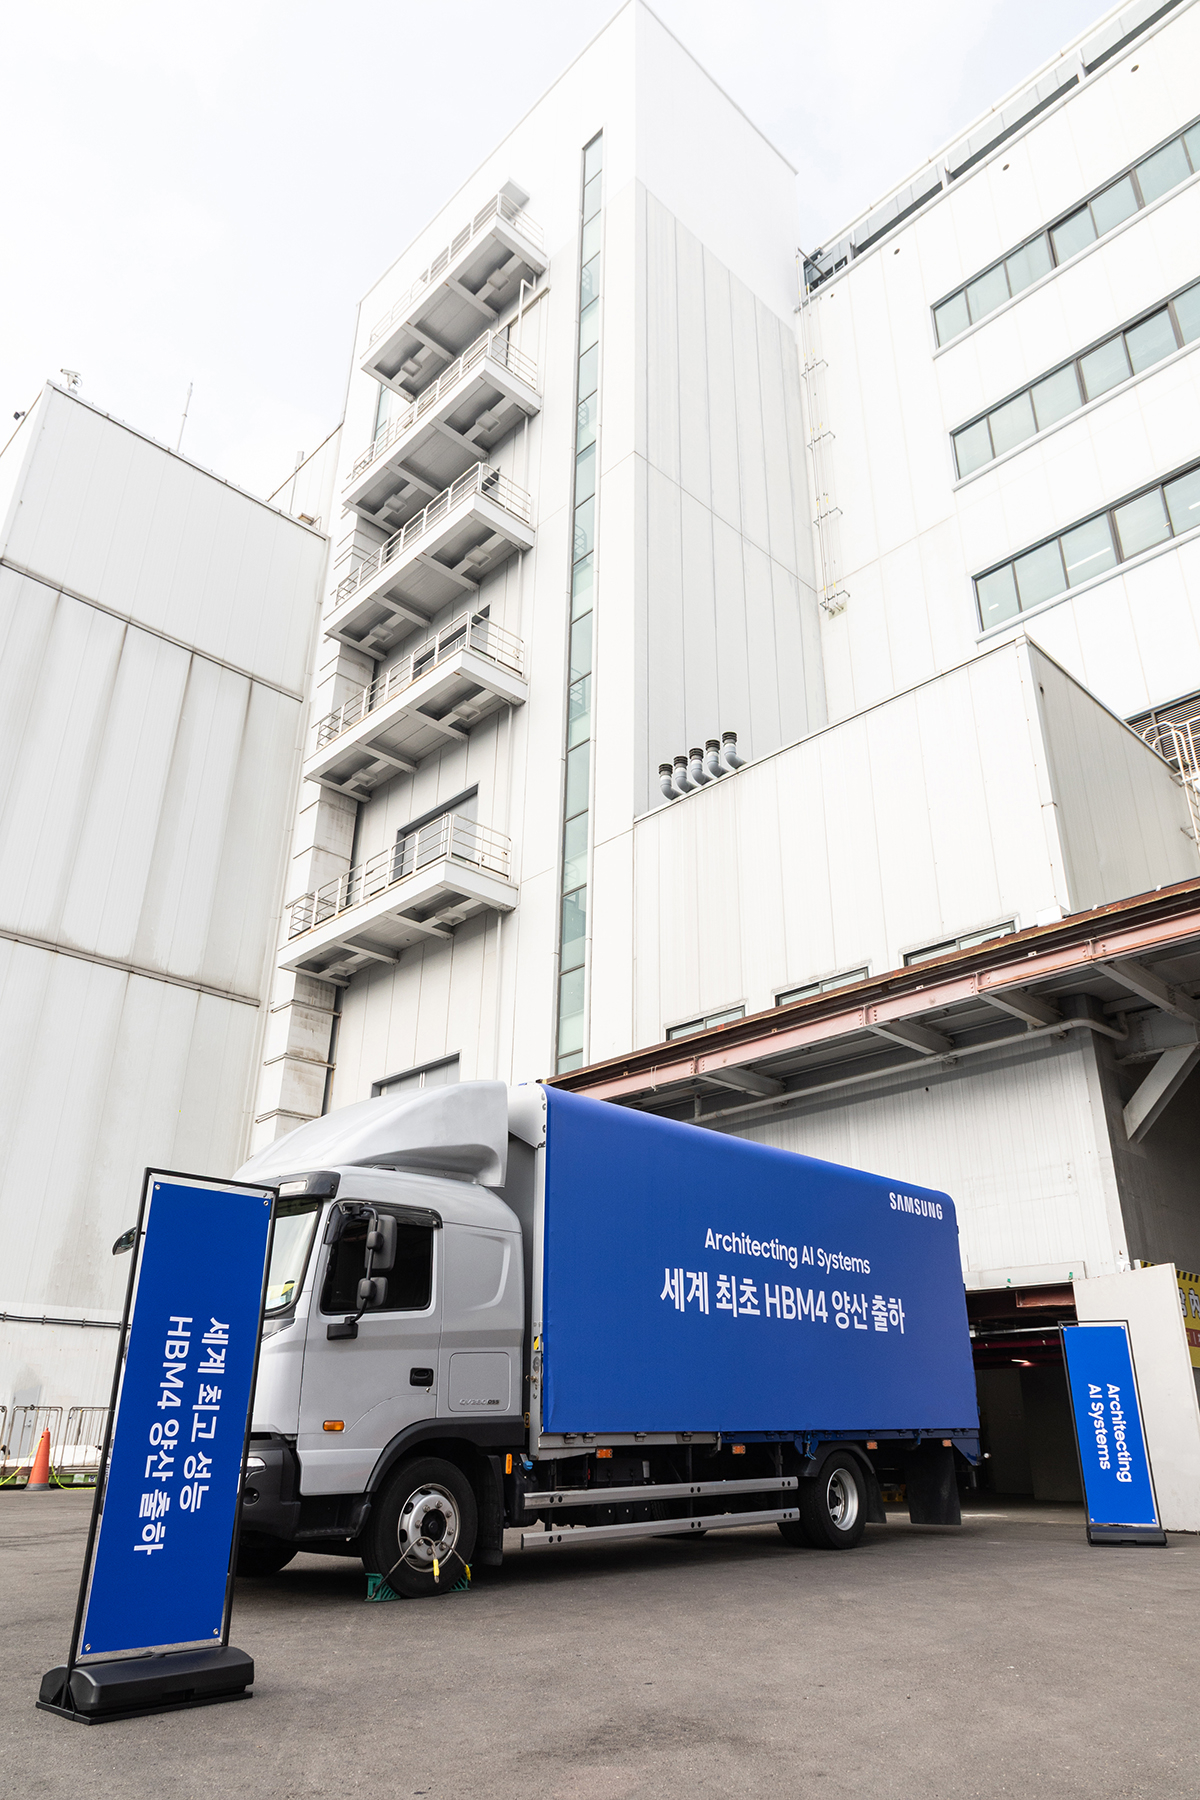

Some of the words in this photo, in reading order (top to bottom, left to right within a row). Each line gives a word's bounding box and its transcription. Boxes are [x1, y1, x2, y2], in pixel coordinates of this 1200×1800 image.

[890, 1191, 943, 1220] SAMSUNG
[705, 1228, 798, 1270] Architecting
[802, 1246, 815, 1266] AI
[817, 1248, 871, 1275] Systems
[660, 1267, 709, 1315] 세계
[716, 1274, 760, 1317] 최초
[765, 1283, 829, 1323] HBM4
[832, 1291, 868, 1330] 양산
[872, 1295, 905, 1334] 출하
[157, 1316, 193, 1410] HBM4
[197, 1317, 230, 1374] 세계
[191, 1384, 222, 1442] 최고
[1088, 1383, 1103, 1399] AI
[145, 1419, 180, 1482] 양산
[1088, 1402, 1111, 1470] Systems
[1106, 1383, 1132, 1483] Architecting
[179, 1451, 213, 1512] 성능
[133, 1489, 170, 1555] 출하
